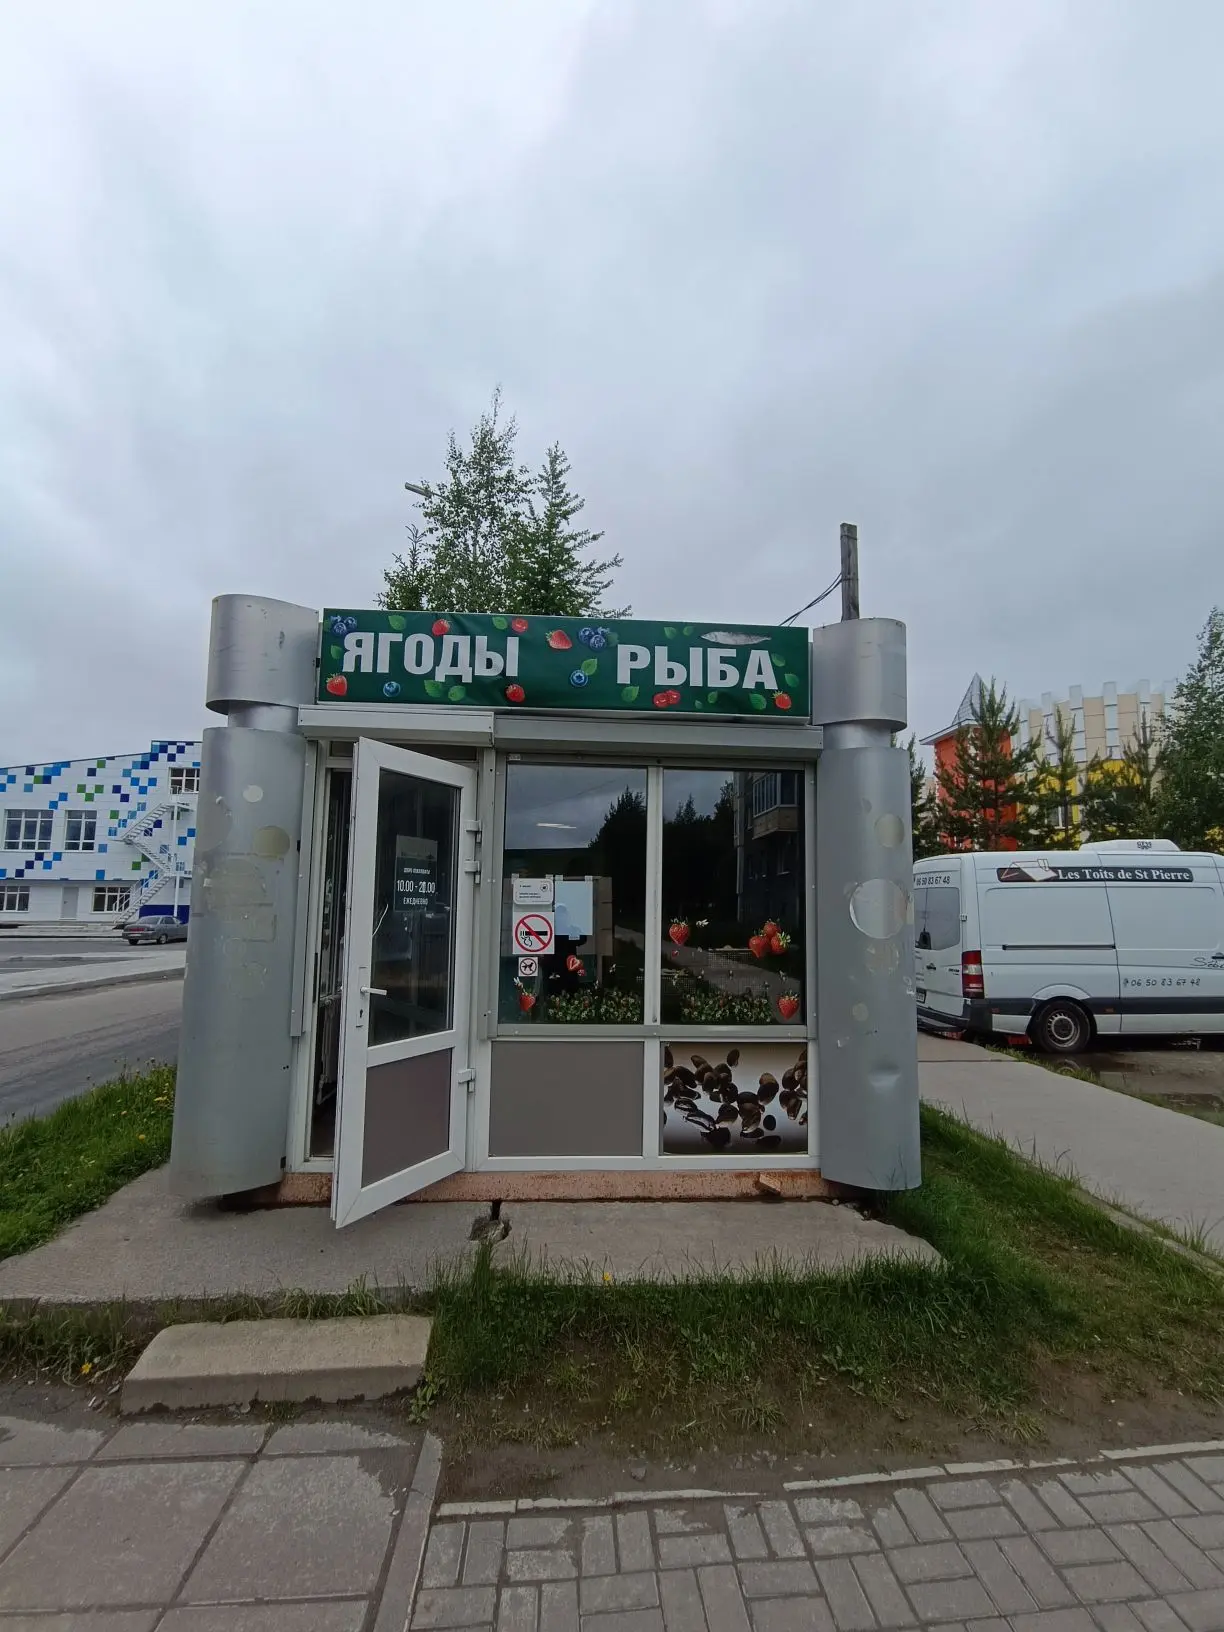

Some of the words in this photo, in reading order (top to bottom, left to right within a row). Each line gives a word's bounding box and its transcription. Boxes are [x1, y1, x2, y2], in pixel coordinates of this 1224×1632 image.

[342, 632, 519, 683] ЯГОДЫ
[616, 644, 778, 690] РЫБА
[1058, 869, 1080, 880] Les
[1082, 869, 1114, 880] Toits
[1118, 869, 1133, 880] de
[1135, 869, 1149, 880] St
[1151, 869, 1190, 880] Pierre
[397, 880, 414, 892] 10.00
[1131, 978, 1142, 987] 06
[1145, 978, 1157, 987] 50
[1176, 978, 1187, 987] 67
